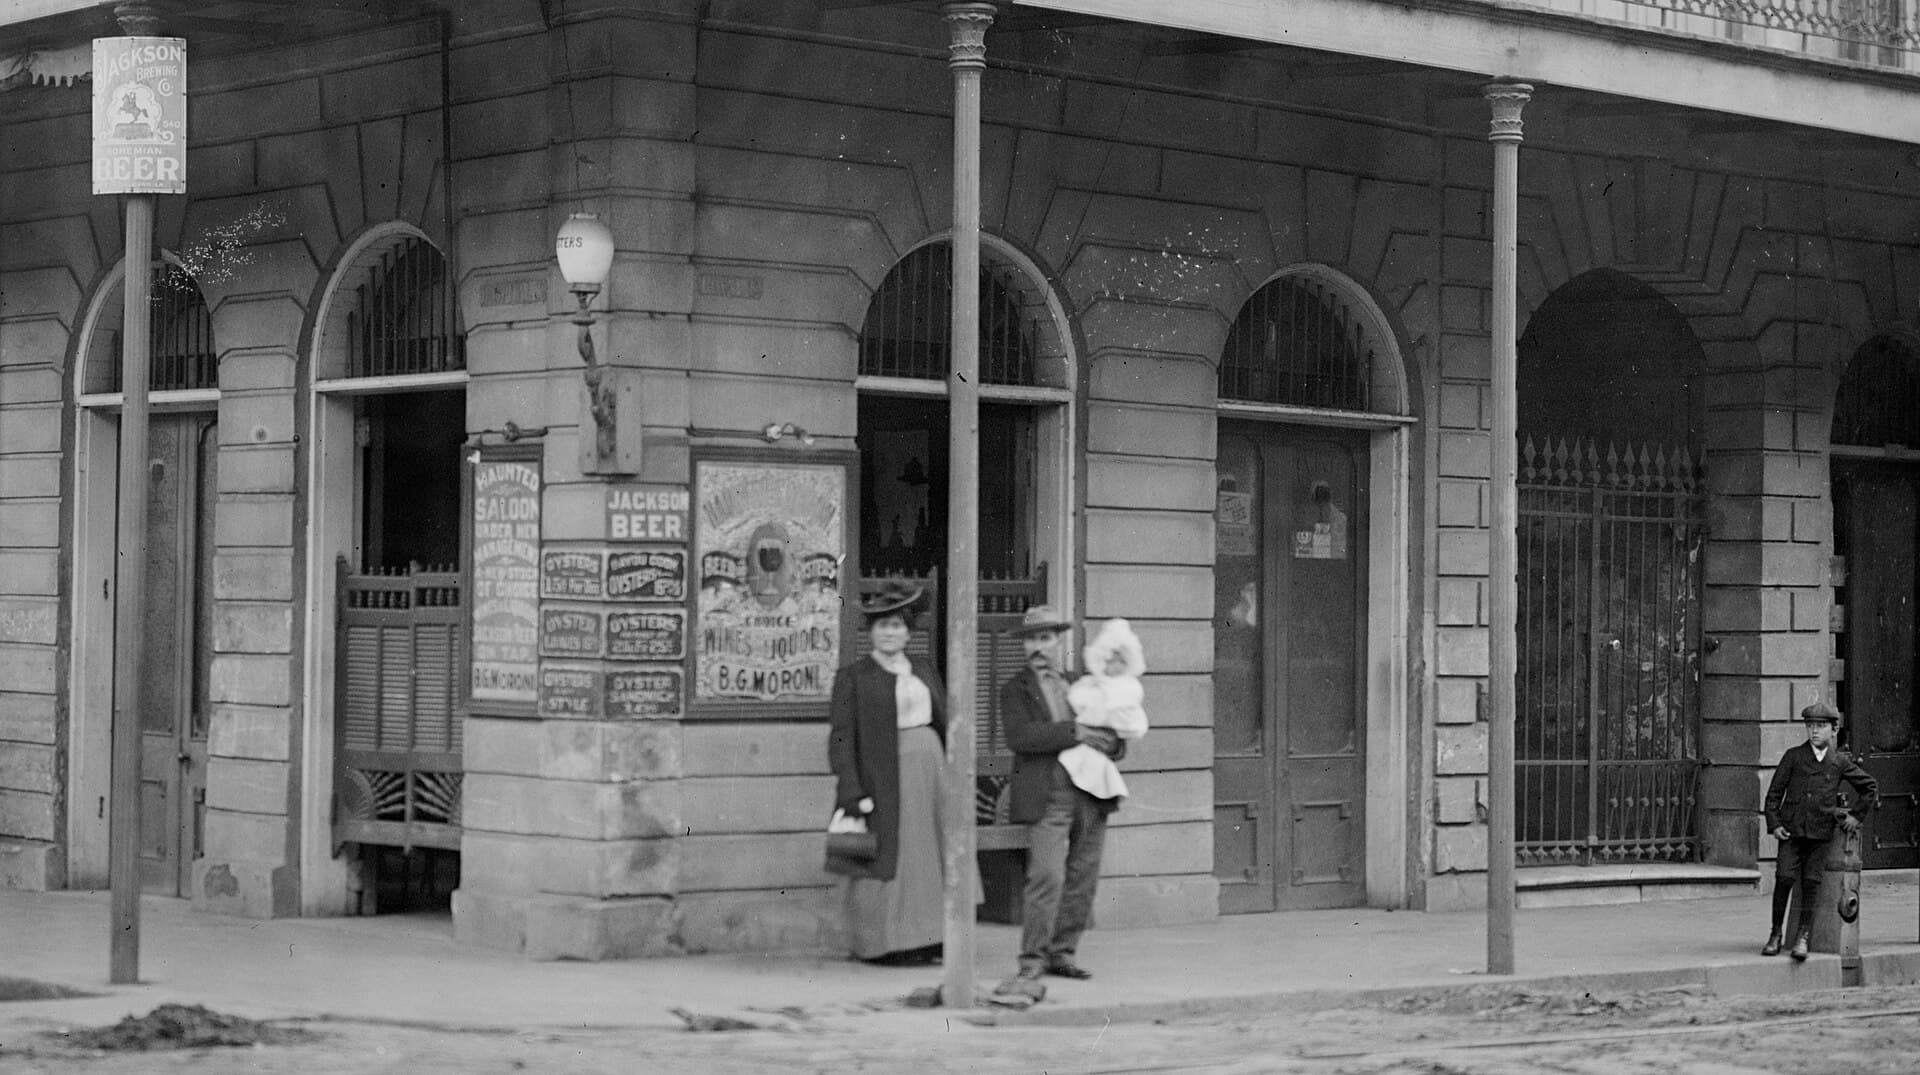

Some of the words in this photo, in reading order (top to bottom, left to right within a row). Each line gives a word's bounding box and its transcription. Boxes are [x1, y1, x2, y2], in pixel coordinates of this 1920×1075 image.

[136, 65, 178, 82] BREWING
[108, 147, 162, 155] OHEMIAN
[95, 156, 180, 181] BEER
[558, 236, 583, 248] TERS
[475, 463, 539, 492] HAUNTED
[475, 497, 539, 521] SALOON
[608, 490, 689, 511] JACKSON
[611, 513, 681, 538] BEER
[546, 554, 599, 574] OYSTERS
[609, 567, 662, 594] OYSTERS
[546, 614, 596, 633] OYSTER
[610, 615, 678, 633] OYSTERS
[548, 697, 589, 711] STYLE
